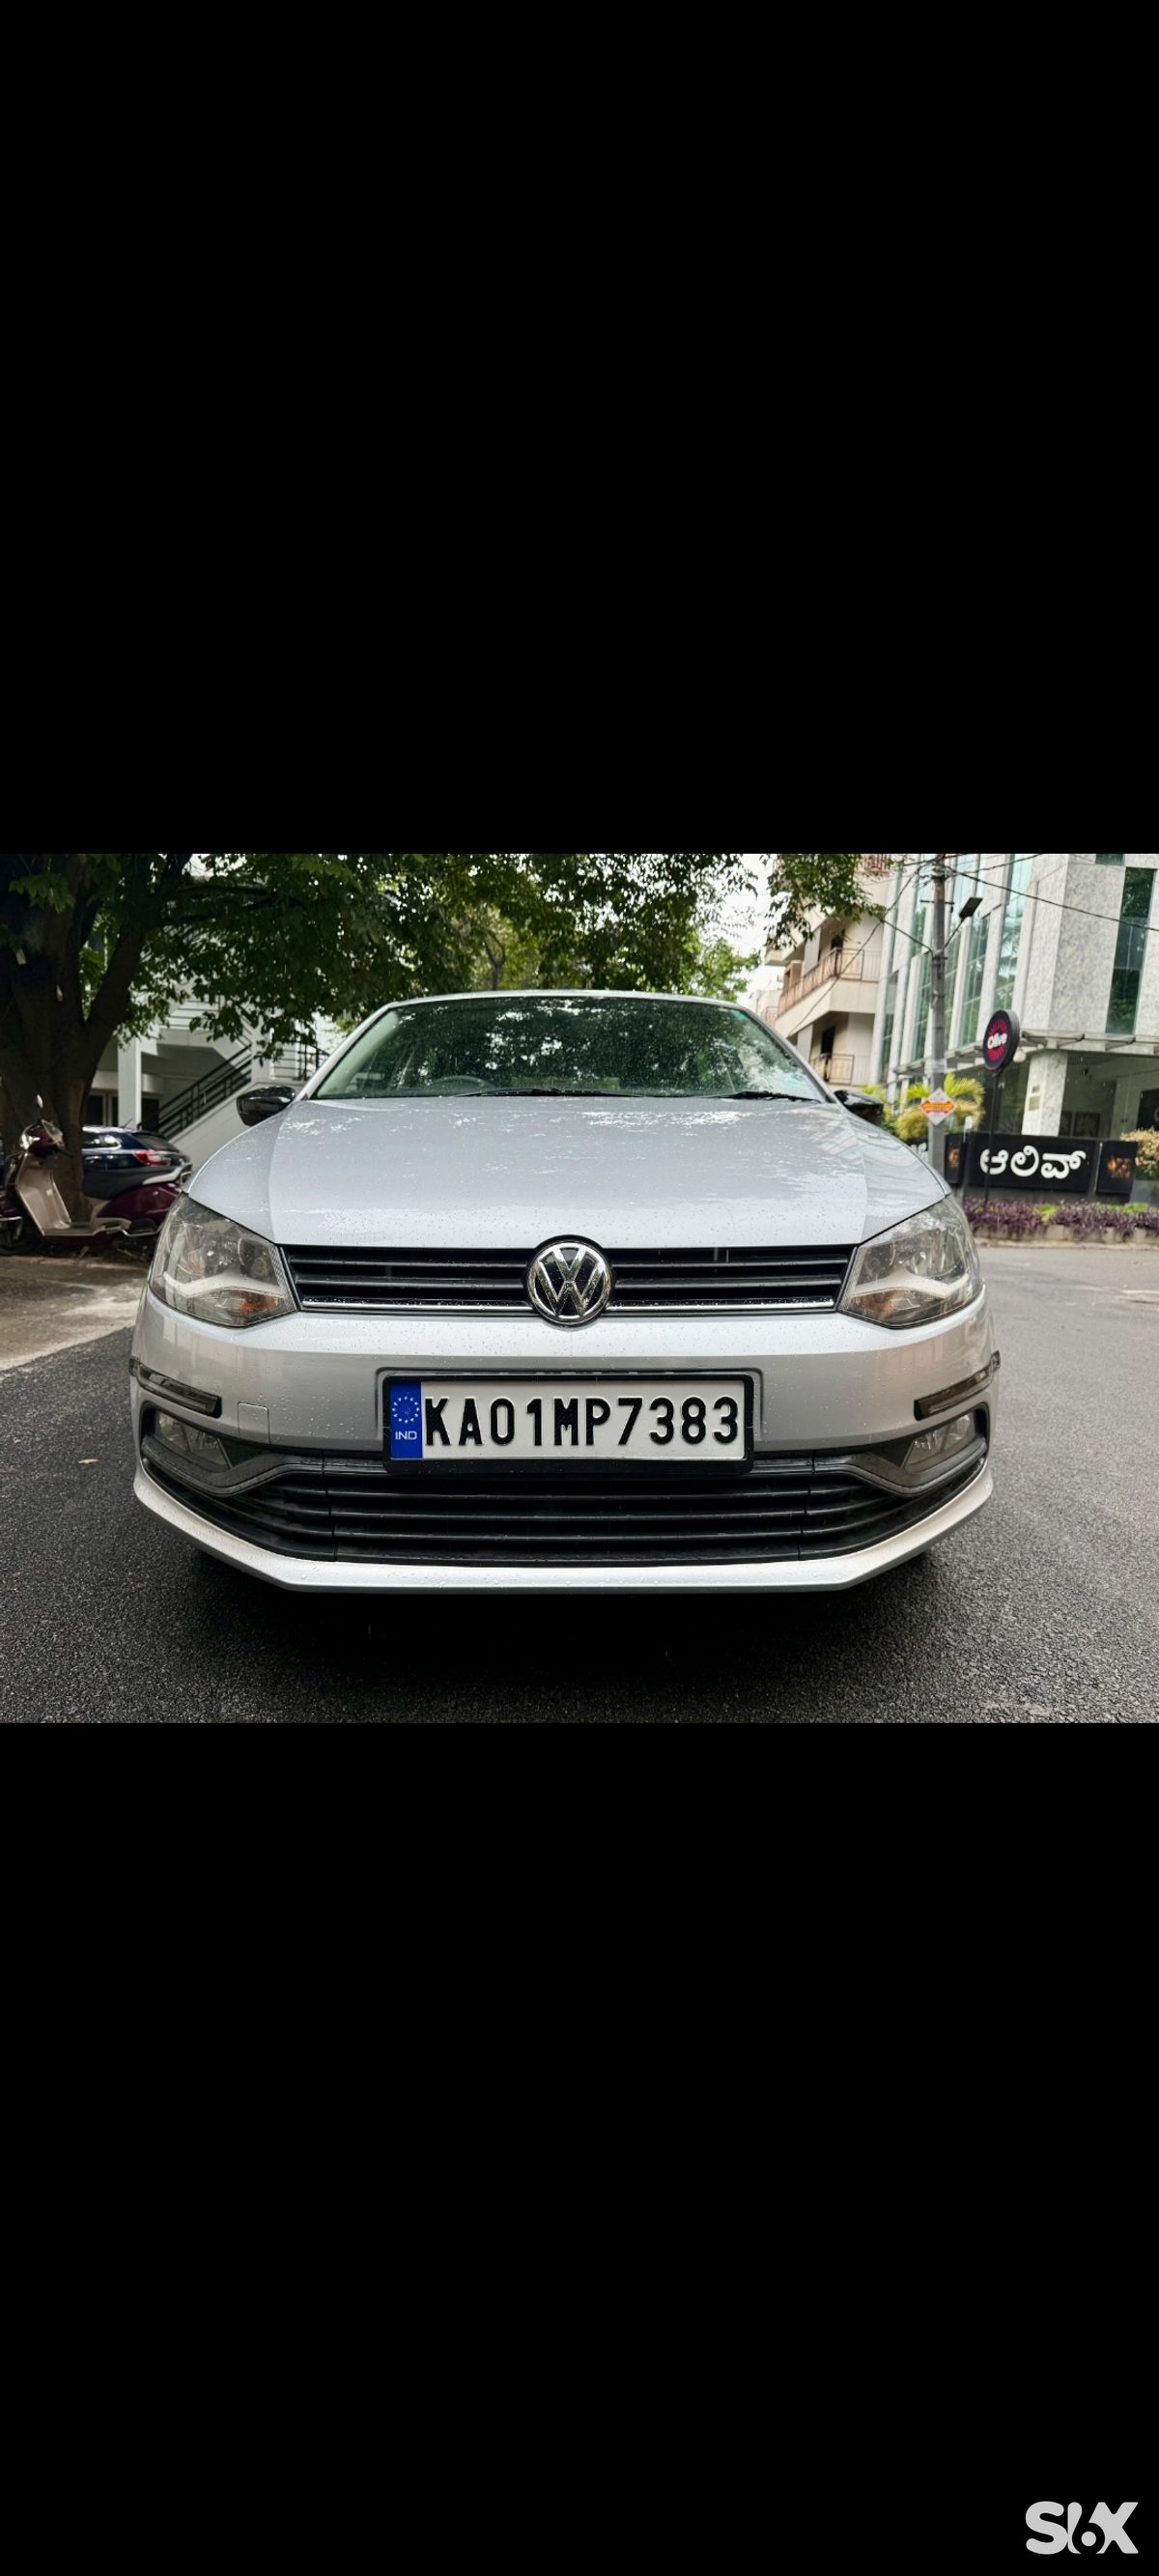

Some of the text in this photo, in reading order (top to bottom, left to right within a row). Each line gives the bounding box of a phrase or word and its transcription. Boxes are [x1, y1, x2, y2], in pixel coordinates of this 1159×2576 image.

[979, 1145, 1087, 1179] ಆಲಿವ್
[395, 1430, 417, 1440] IND
[425, 1396, 739, 1446] KA01MP7383
